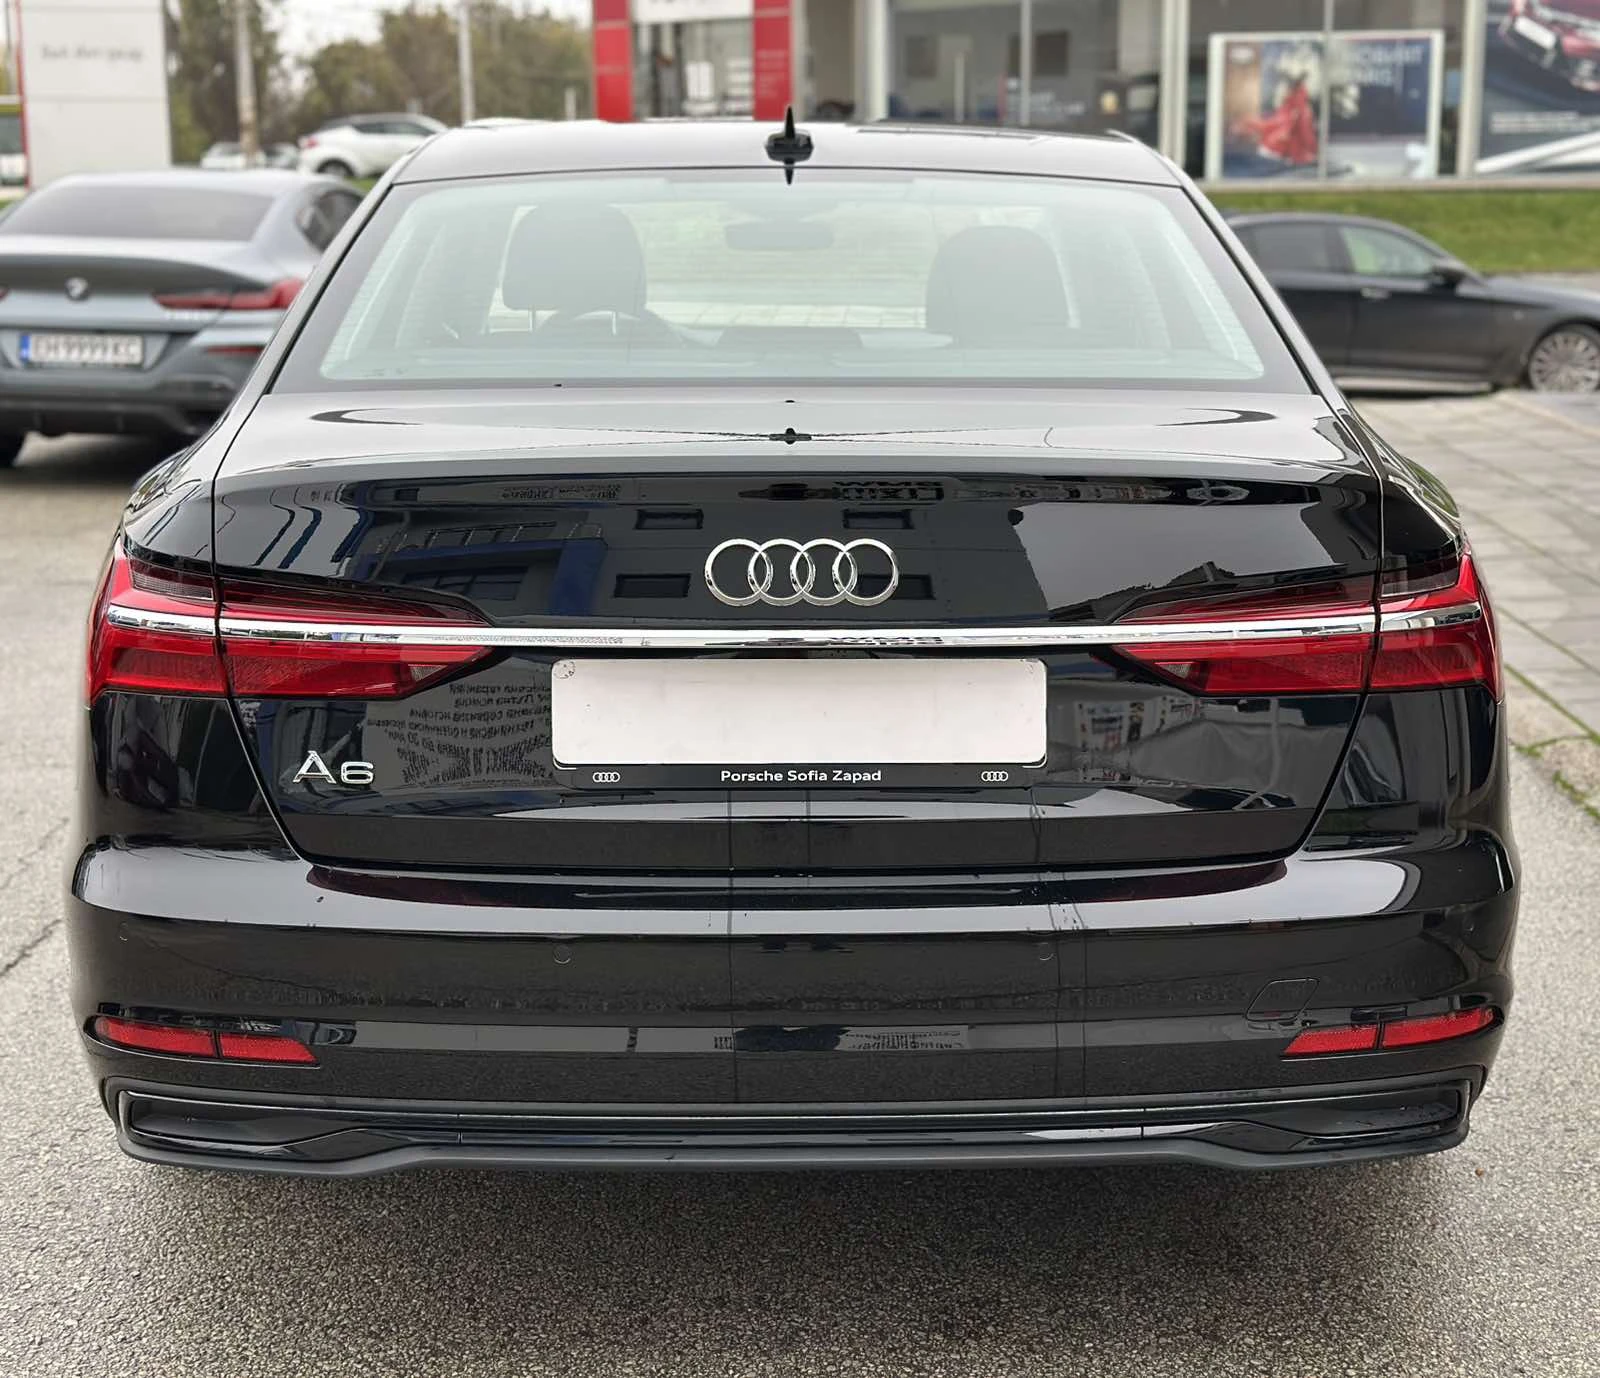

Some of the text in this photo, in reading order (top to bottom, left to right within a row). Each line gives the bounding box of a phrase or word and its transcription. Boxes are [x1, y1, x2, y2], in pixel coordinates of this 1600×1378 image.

[292, 750, 374, 784] A6
[720, 770, 882, 783] Porsche Sofia Zapad
